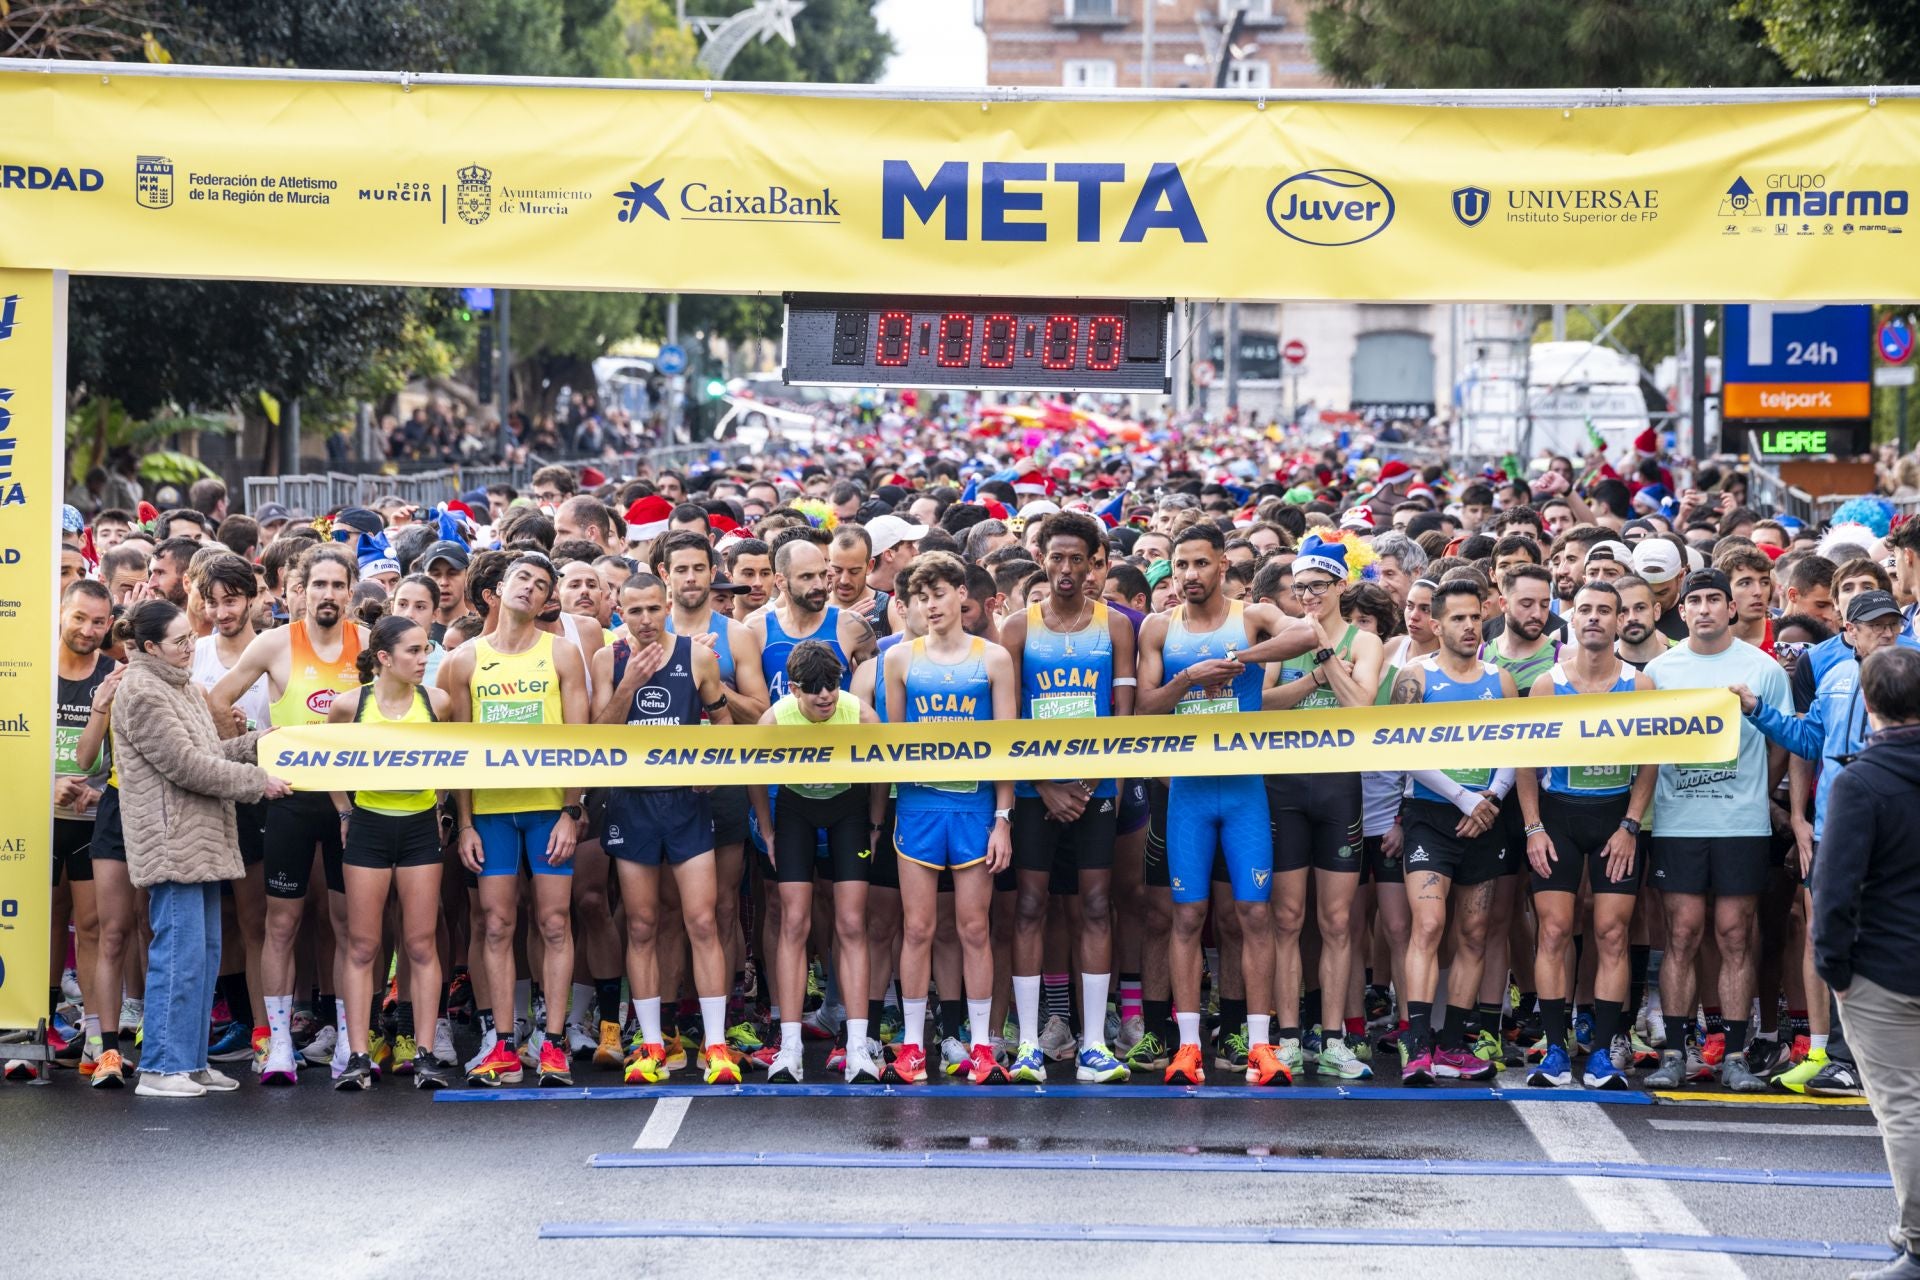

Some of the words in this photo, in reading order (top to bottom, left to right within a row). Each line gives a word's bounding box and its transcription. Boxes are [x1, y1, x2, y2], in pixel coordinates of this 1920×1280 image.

[139, 164, 170, 173] FAMU
[0, 164, 105, 192] RDAD
[189, 173, 258, 187] Federación
[260, 175, 276, 188] de
[278, 176, 338, 190] Atletismo
[396, 182, 430, 190] 1200
[1766, 173, 1826, 192] Grupo
[189, 188, 205, 201] de
[208, 189, 220, 201] la
[222, 188, 266, 204] Región
[268, 191, 284, 204] de
[287, 192, 330, 205] Murcia
[358, 189, 432, 202] MURCIA
[499, 186, 592, 201] Ayuntamiento
[681, 183, 841, 216] CaixaBank
[882, 160, 1209, 243] META
[1508, 190, 1659, 209] UNIVERSAE
[499, 203, 512, 214] de
[519, 202, 569, 215] Murcia
[1280, 193, 1382, 221] Juver
[1766, 190, 1909, 217] marmo
[1507, 212, 1560, 222] Instituto
[1562, 211, 1618, 225] Superior
[1620, 211, 1638, 222] de
[1641, 211, 1658, 222] FP
[1785, 342, 1839, 365] 24h
[1762, 431, 1827, 453] LIBRE
[0, 669, 17, 677] rcia
[1036, 667, 1099, 691] UCAM
[487, 703, 509, 714] SAN
[641, 700, 666, 709] Reina
[915, 693, 977, 715] UCAM
[1039, 701, 1059, 711] SAN
[1182, 703, 1201, 714] SAN
[487, 703, 539, 723] SILVESTRE
[276, 751, 331, 767] SAN
[333, 750, 469, 767] SILVESTRE
[485, 749, 520, 767] LA
[523, 748, 629, 767] VERDAD
[645, 748, 699, 765] SAN
[701, 746, 835, 765] SILVESTRE
[850, 744, 884, 763] LA
[886, 741, 992, 761] VERDAD
[1008, 739, 1062, 757] SAN
[1064, 735, 1198, 756] SILVESTRE
[1213, 732, 1247, 752] LA
[1249, 728, 1355, 750] VERDAD
[1372, 726, 1426, 745] SAN
[1428, 721, 1563, 743] SILVESTRE
[1580, 718, 1615, 738] LA
[1615, 715, 1724, 737] VERDAD
[14, 853, 26, 862] FP
